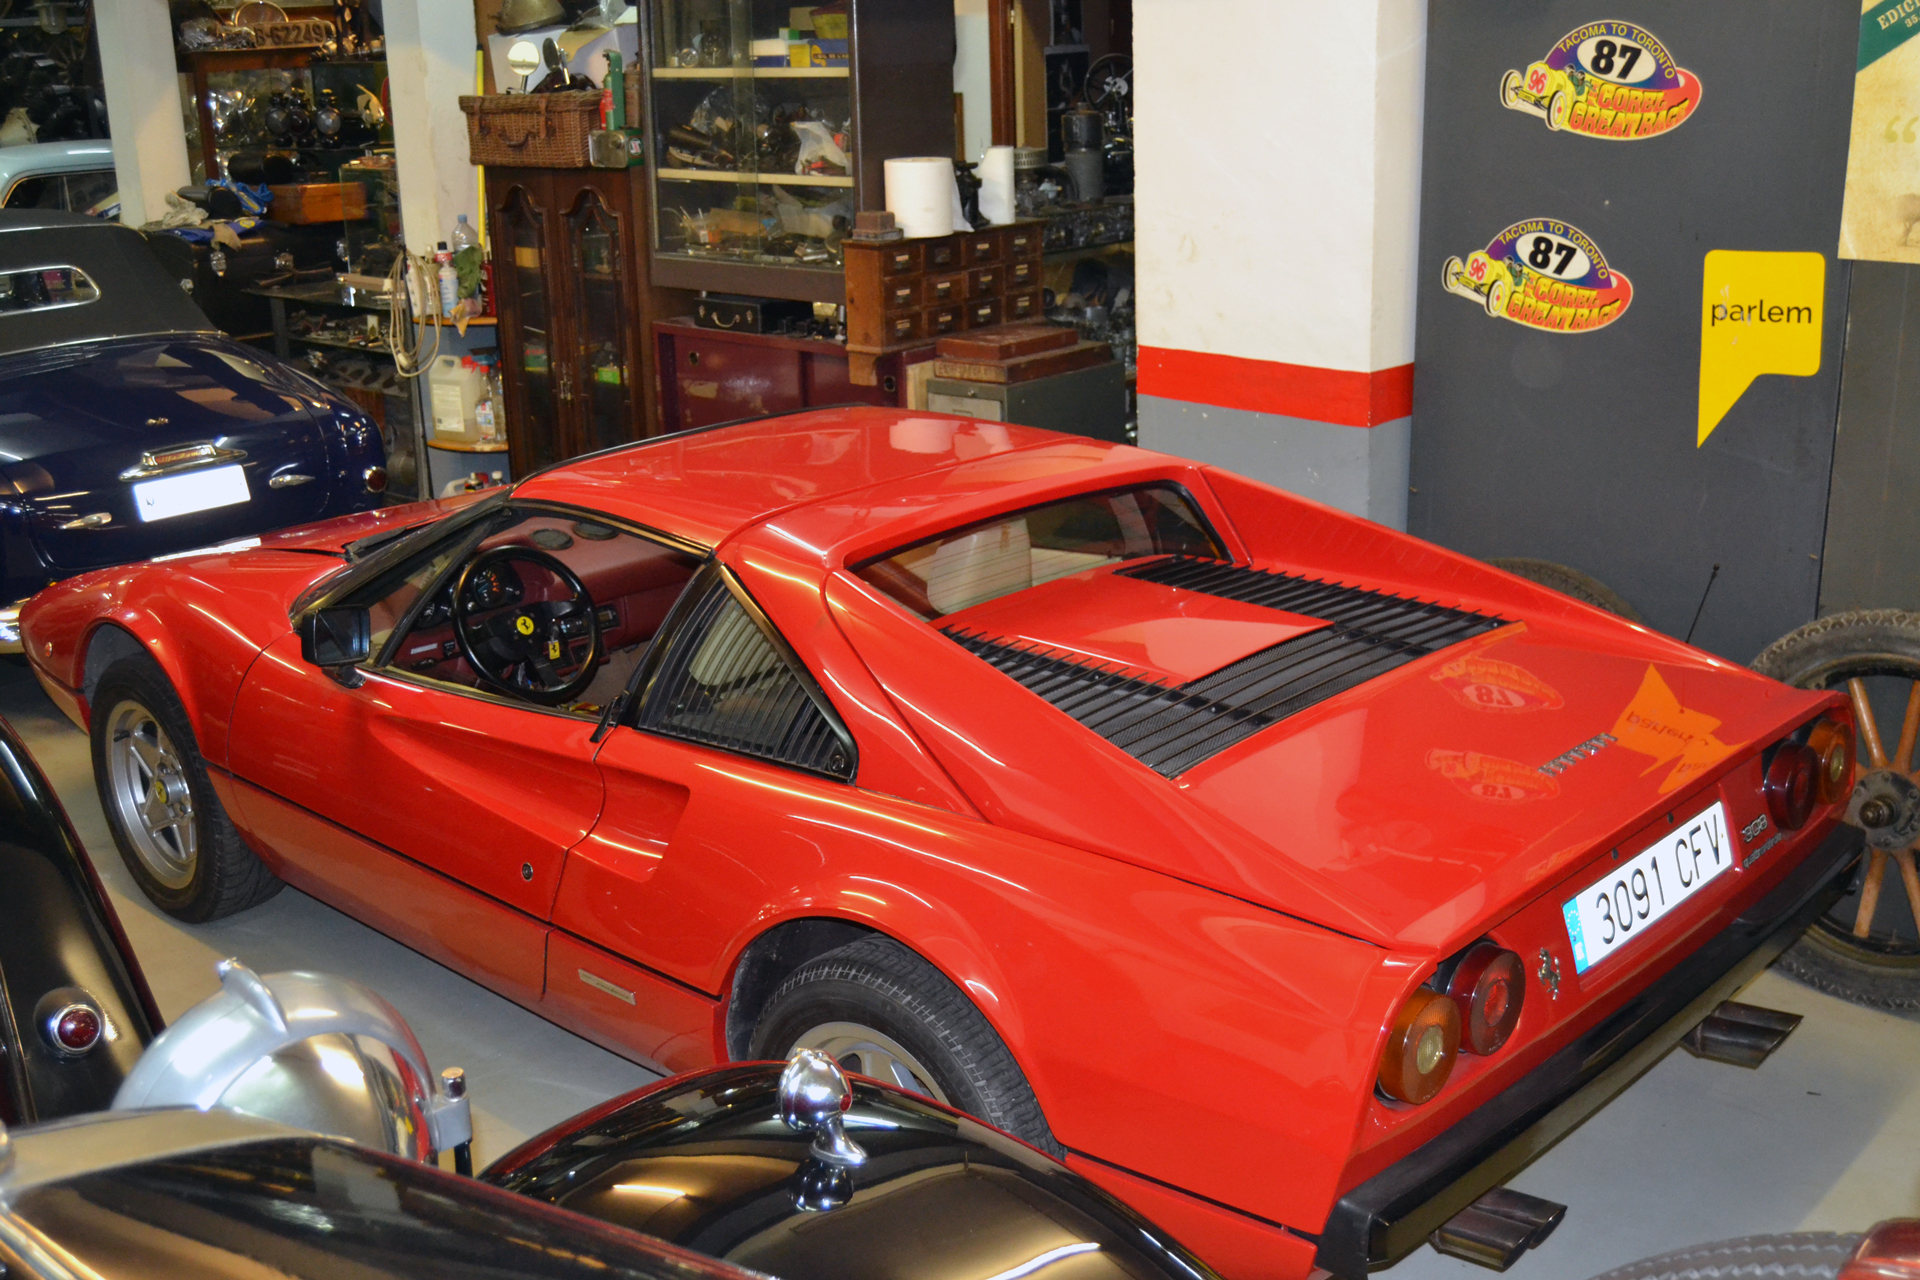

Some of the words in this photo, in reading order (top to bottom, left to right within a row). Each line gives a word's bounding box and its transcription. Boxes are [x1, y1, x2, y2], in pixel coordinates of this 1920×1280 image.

[1558, 23, 1607, 52] TACOMA
[1611, 23, 1628, 37] TO
[1631, 28, 1675, 80] TORONTO
[1590, 39, 1643, 80] 87
[1527, 69, 1547, 94] 96
[1598, 83, 1667, 113] COREL
[1569, 101, 1637, 138] GREAT
[1498, 221, 1545, 245] TACOMA
[1548, 222, 1564, 235] TO
[1567, 228, 1608, 280] TORONTO
[1528, 236, 1578, 276] 87
[1468, 258, 1487, 281] 96
[1506, 290, 1571, 330] GREAT
[1533, 277, 1600, 309] COREL
[1711, 299, 1812, 327] parlem
[1742, 813, 1768, 842] 308
[1596, 856, 1665, 944] 3091
[1675, 814, 1720, 888] CFV
